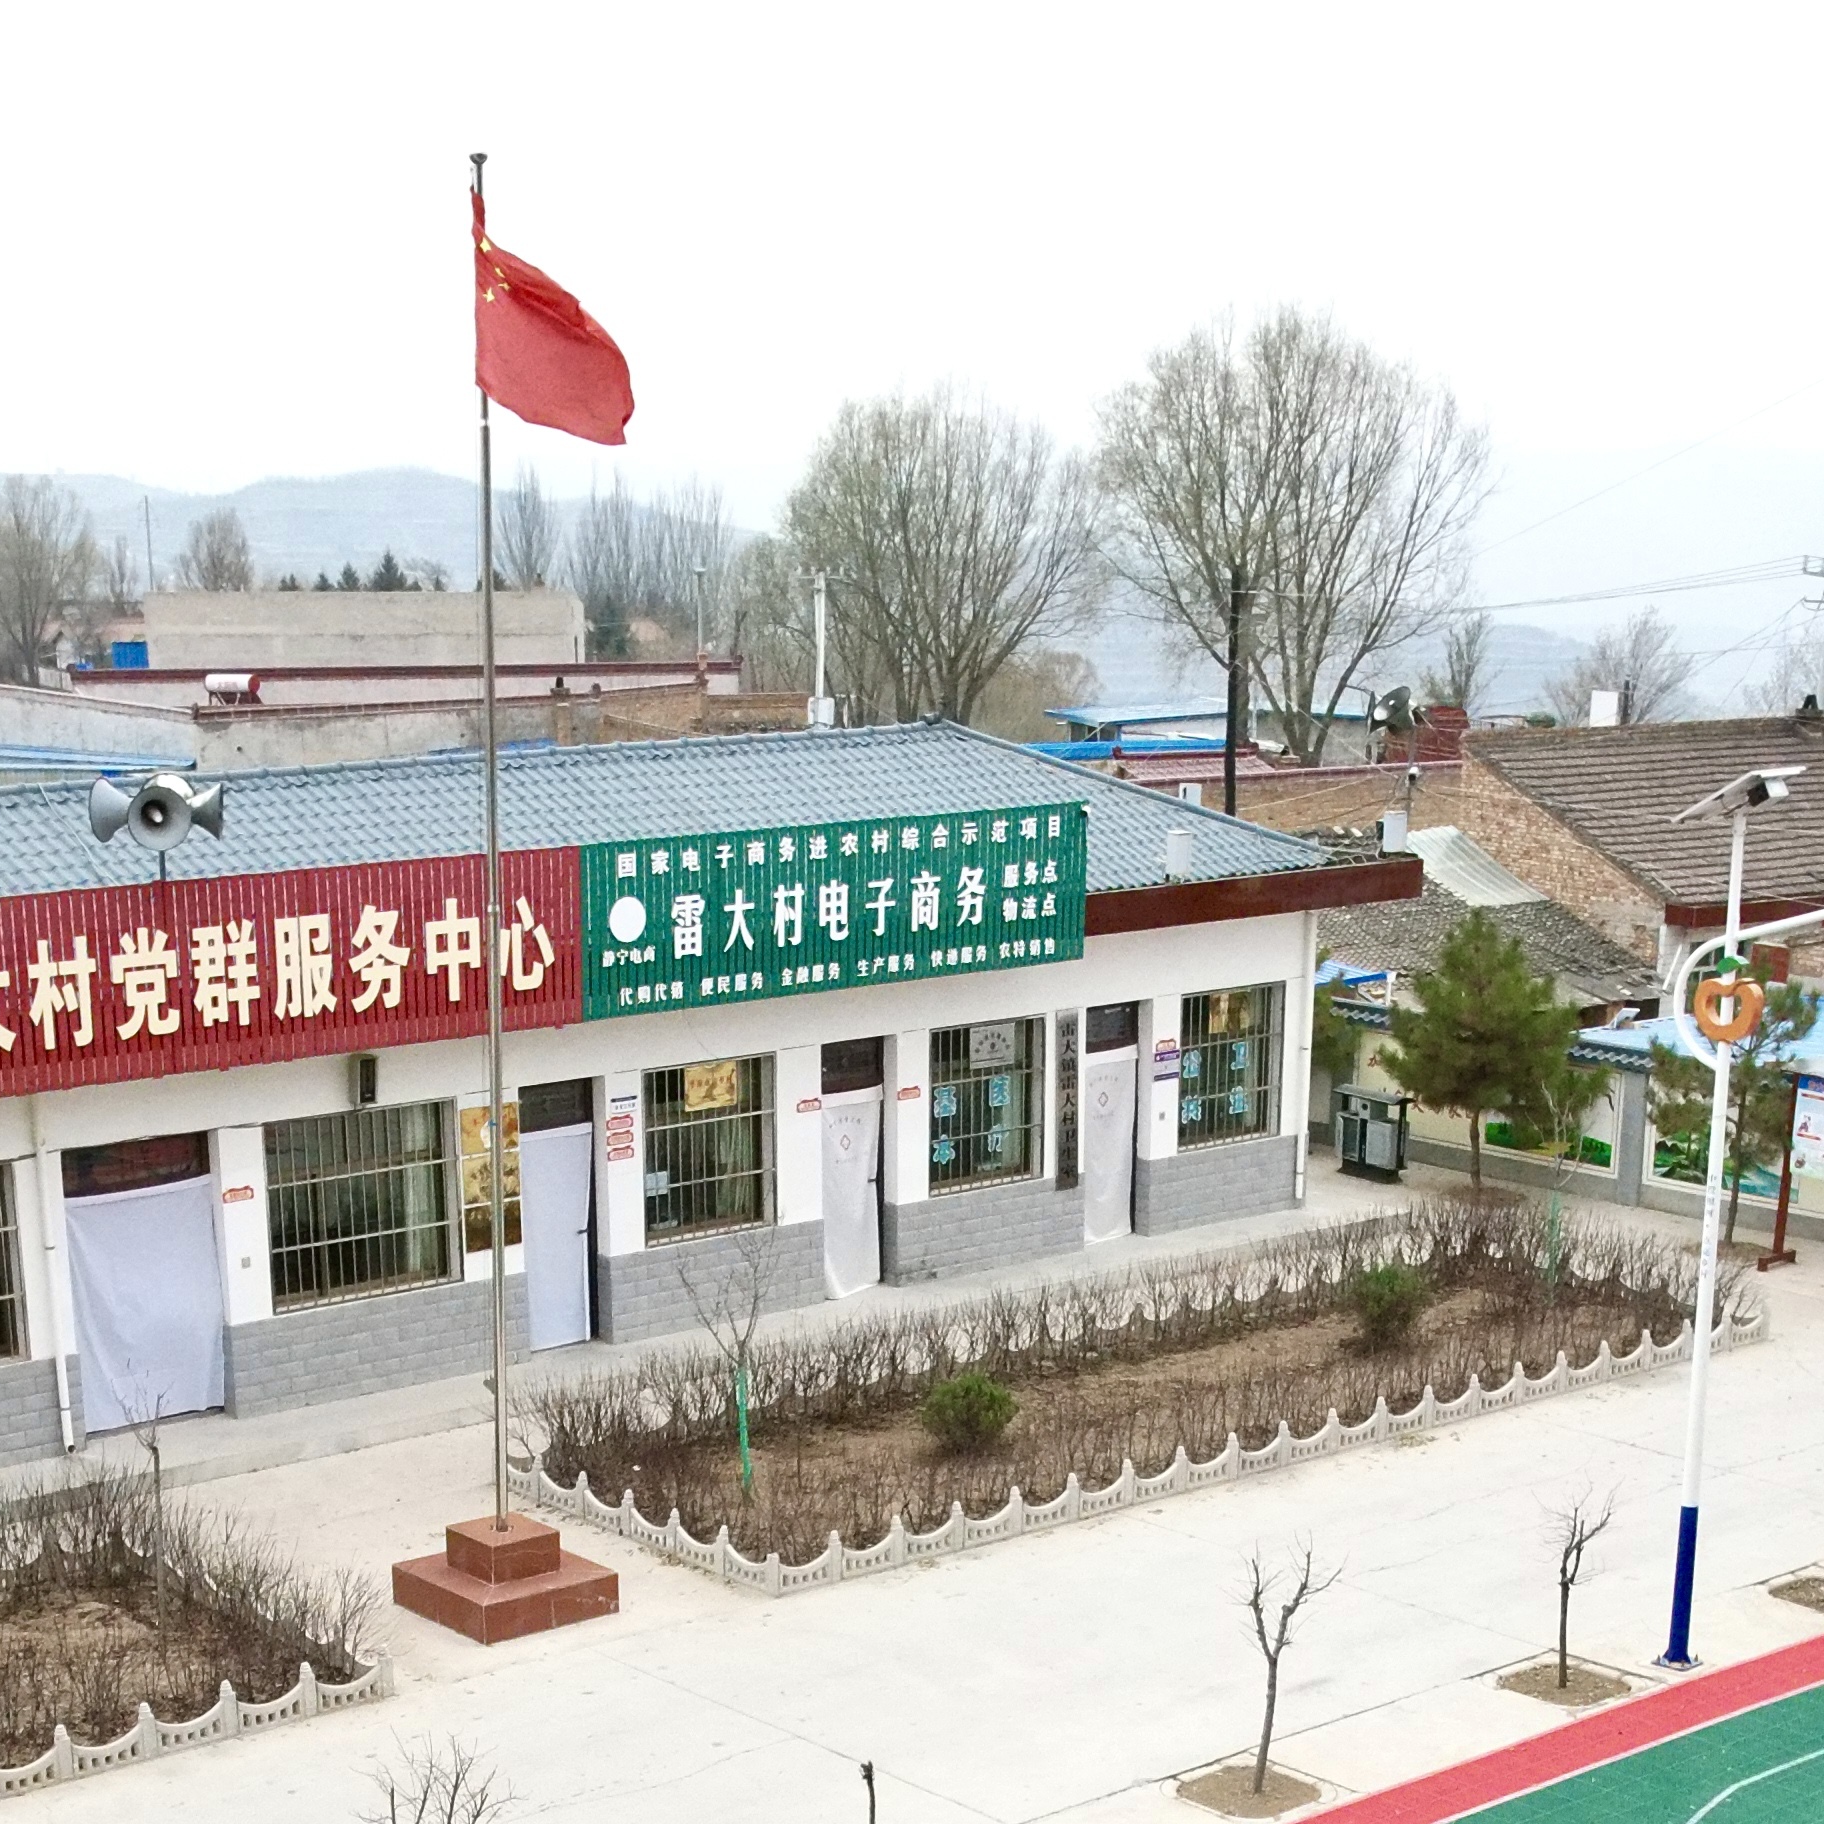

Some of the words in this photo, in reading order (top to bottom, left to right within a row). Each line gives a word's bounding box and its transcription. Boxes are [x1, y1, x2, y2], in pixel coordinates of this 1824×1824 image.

[616, 814, 1061, 879] 国家电子商务进农村综合示范项目
[1002, 858, 1058, 888] 服务点
[671, 865, 985, 960] 雷大村电子商务
[1002, 892, 1057, 922] 物流点
[602, 945, 656, 968] 静宁电商
[619, 980, 684, 1007] 代购代销
[699, 971, 764, 997] 便民服务
[781, 962, 841, 987] 金融服务
[856, 953, 915, 977] 生产服务
